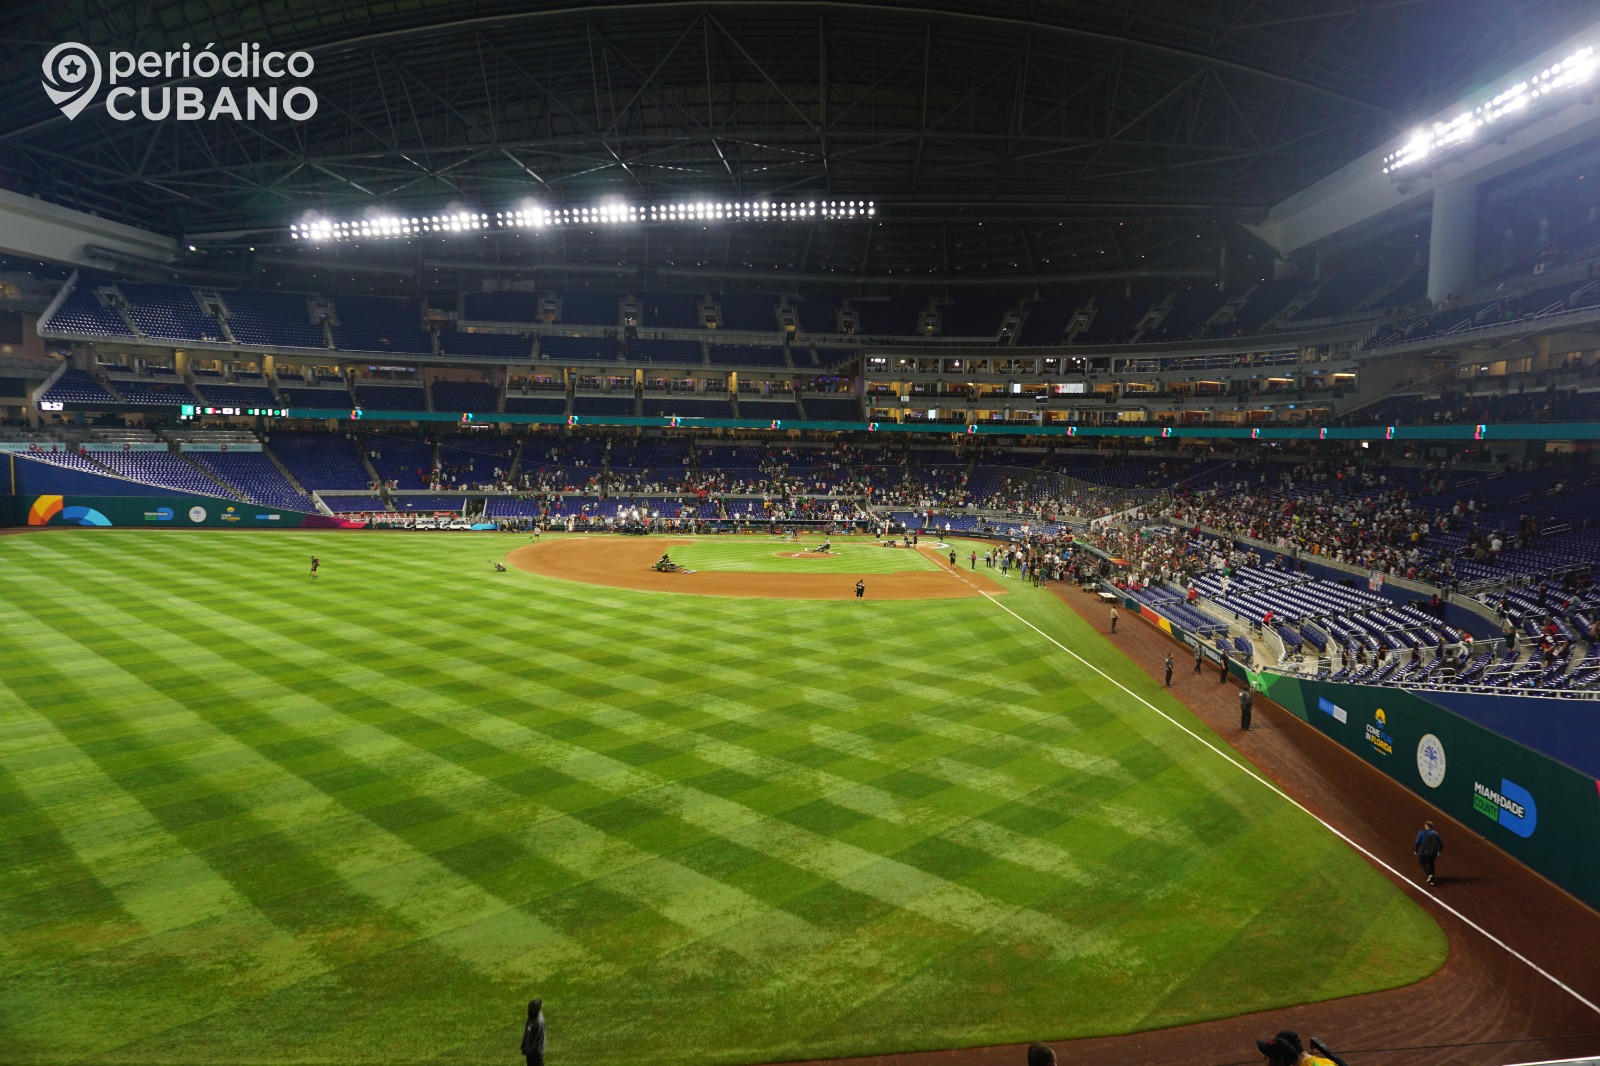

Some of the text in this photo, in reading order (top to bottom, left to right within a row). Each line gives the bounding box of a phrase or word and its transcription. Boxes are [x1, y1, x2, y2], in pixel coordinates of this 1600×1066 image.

[1365, 732, 1372, 741] IN
[1371, 735, 1393, 755] FLORIDA
[1366, 724, 1393, 744] COME PLAY
[1474, 781, 1524, 818] MIAMI-DADE
[1474, 796, 1498, 818] COUNTY
